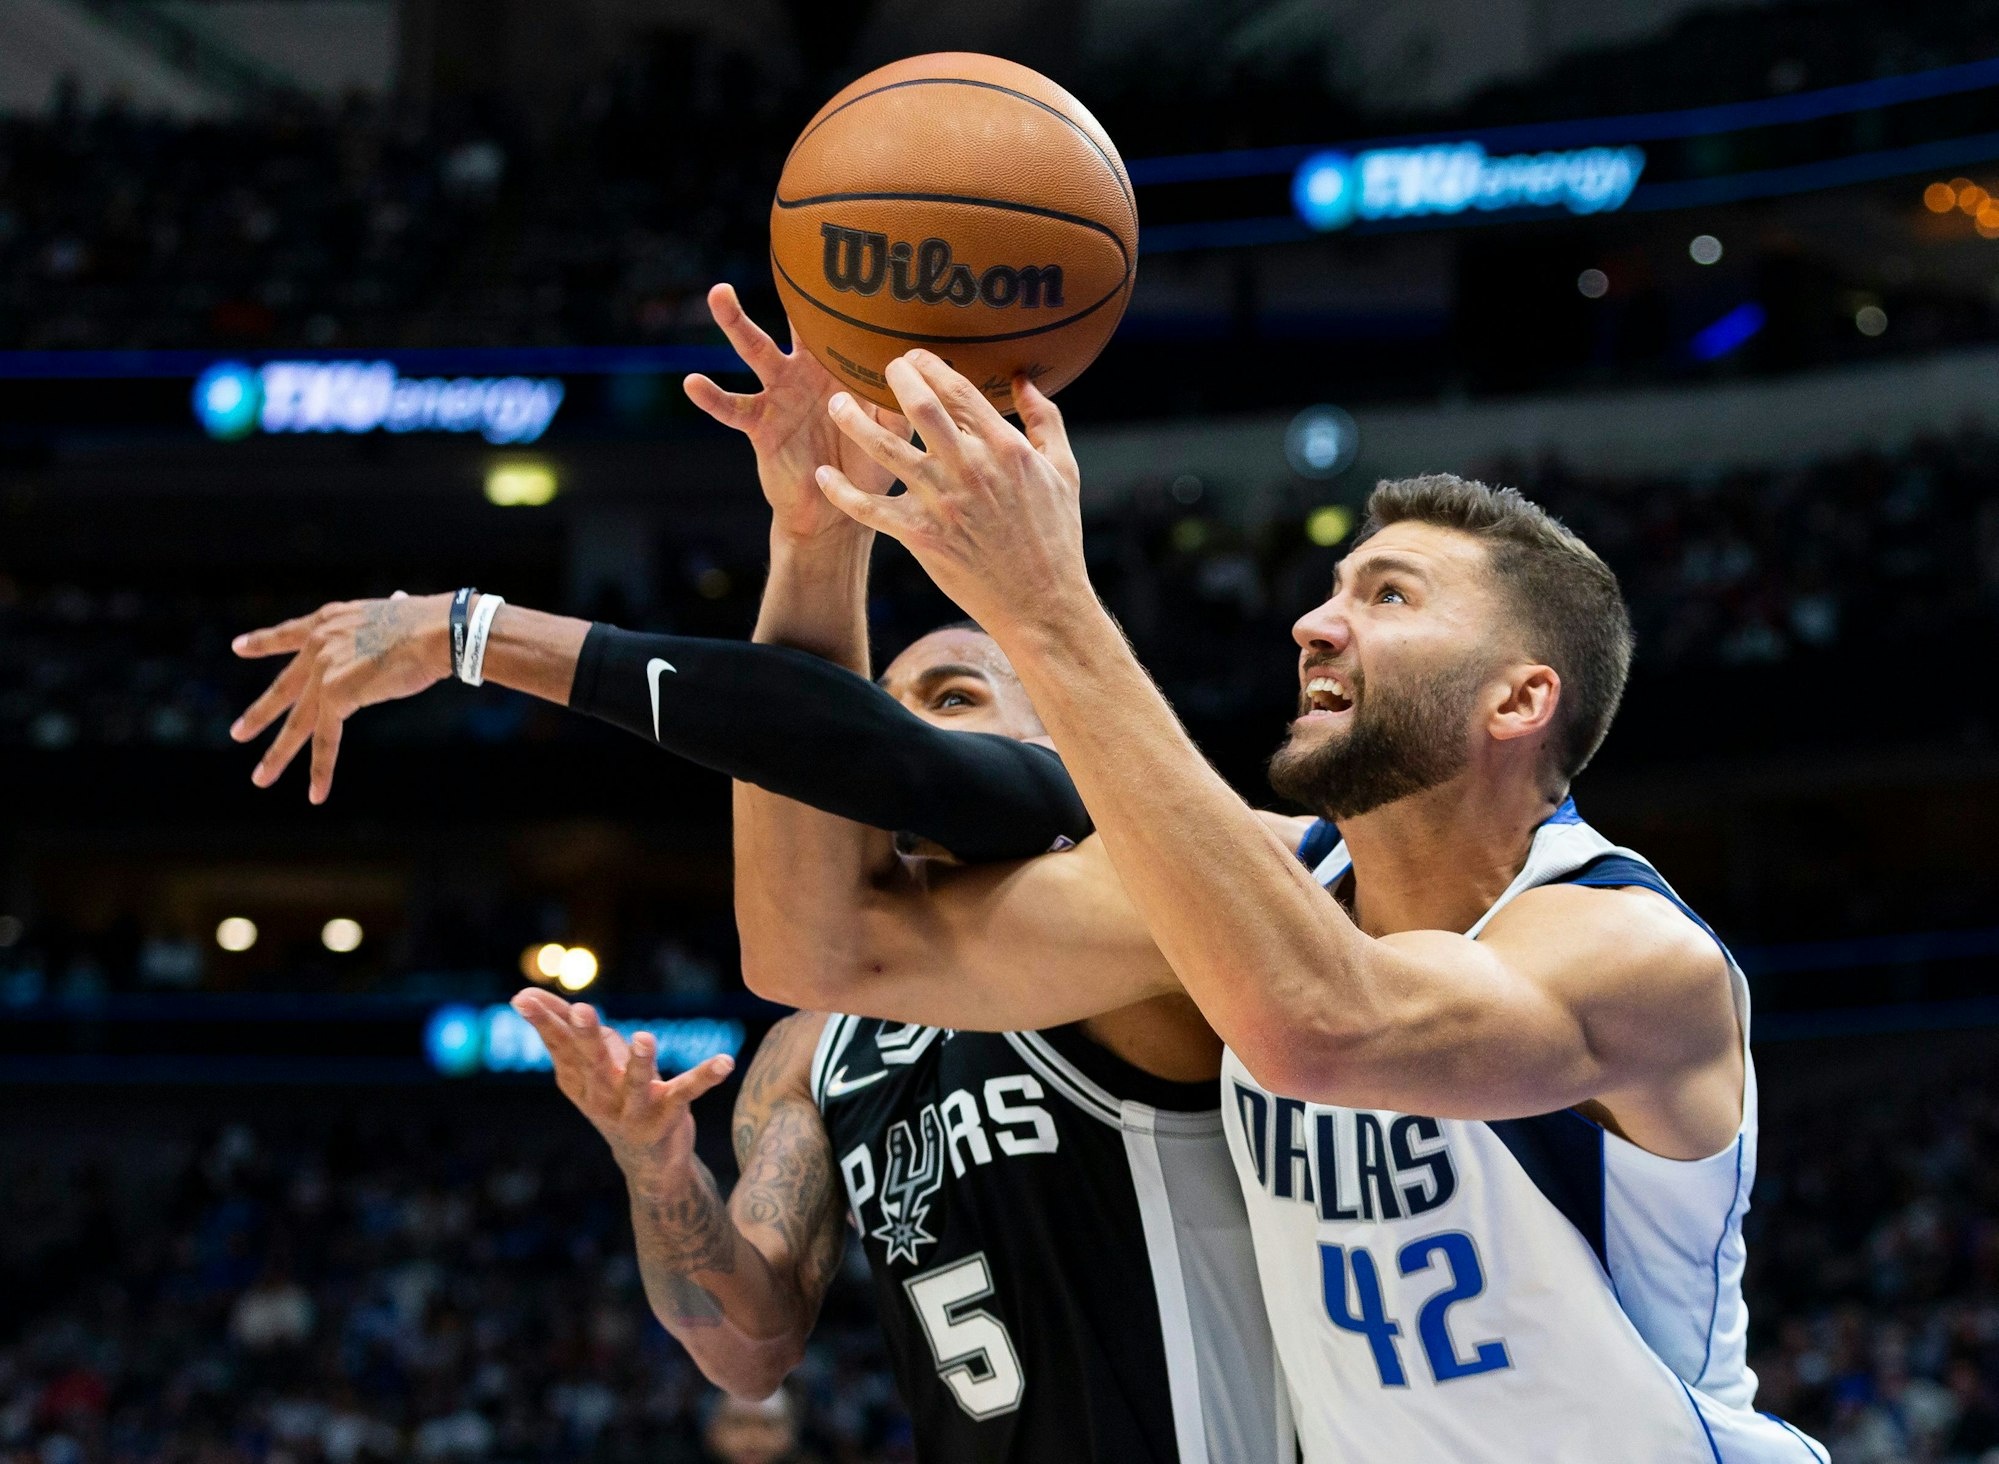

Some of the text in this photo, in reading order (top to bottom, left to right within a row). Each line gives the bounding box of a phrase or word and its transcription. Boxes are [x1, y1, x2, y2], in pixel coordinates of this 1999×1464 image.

[821, 222, 1064, 309] Wilson
[841, 1074, 1059, 1264] PURS
[903, 1250, 1025, 1422] 5
[1316, 1229, 1515, 1391] 42
